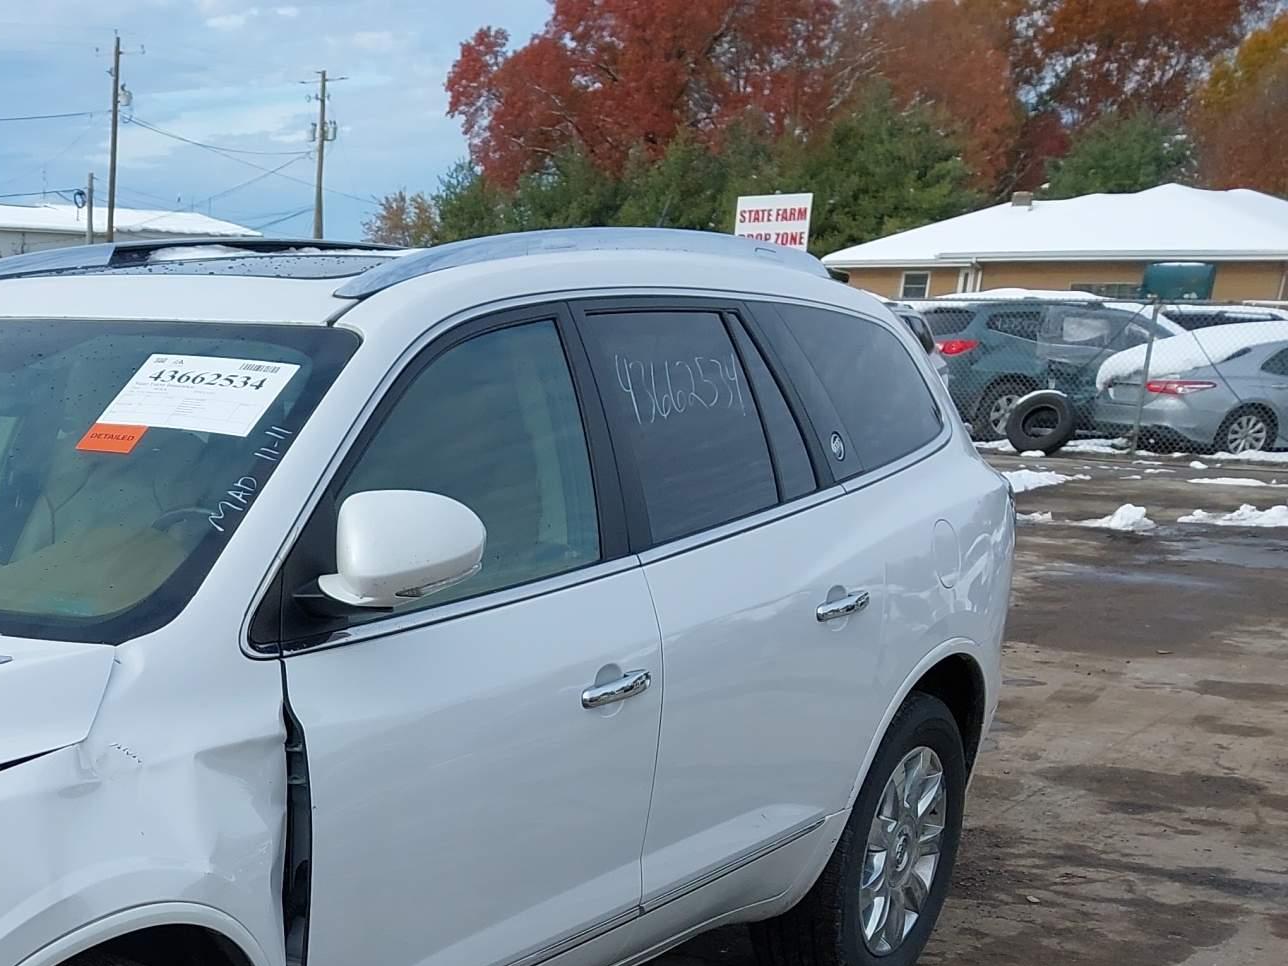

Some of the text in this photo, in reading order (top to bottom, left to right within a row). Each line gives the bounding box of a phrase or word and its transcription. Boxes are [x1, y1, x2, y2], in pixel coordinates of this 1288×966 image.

[739, 207, 808, 223] STATE FARM
[775, 232, 806, 246] ZONE
[148, 369, 268, 390] 43662534
[614, 353, 747, 424] 43662534
[89, 432, 135, 442] DETAILED
[208, 476, 257, 532] MAD
